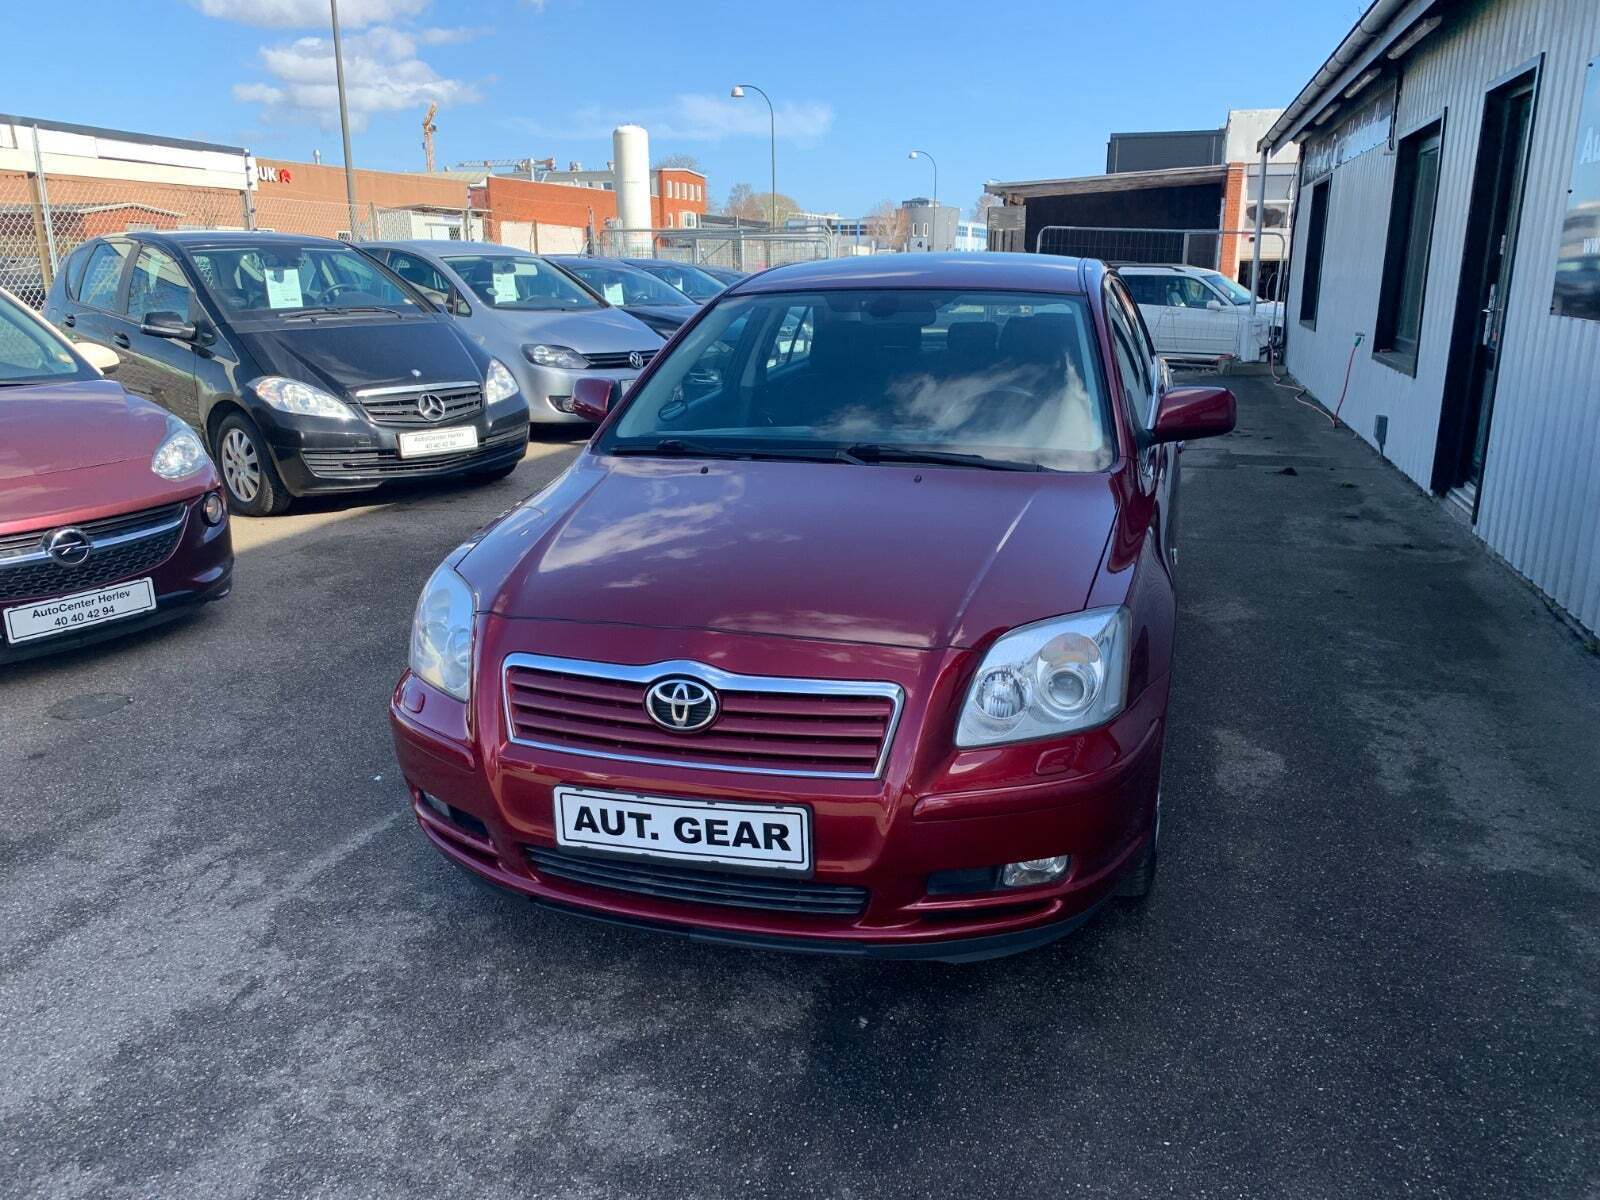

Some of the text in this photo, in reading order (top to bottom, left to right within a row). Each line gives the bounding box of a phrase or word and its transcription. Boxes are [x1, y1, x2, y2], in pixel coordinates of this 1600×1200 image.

[32, 590, 130, 618] AutoCenter Herlev
[54, 605, 115, 627] 40 40 42 94
[573, 805, 792, 852] AUT. GEAR
